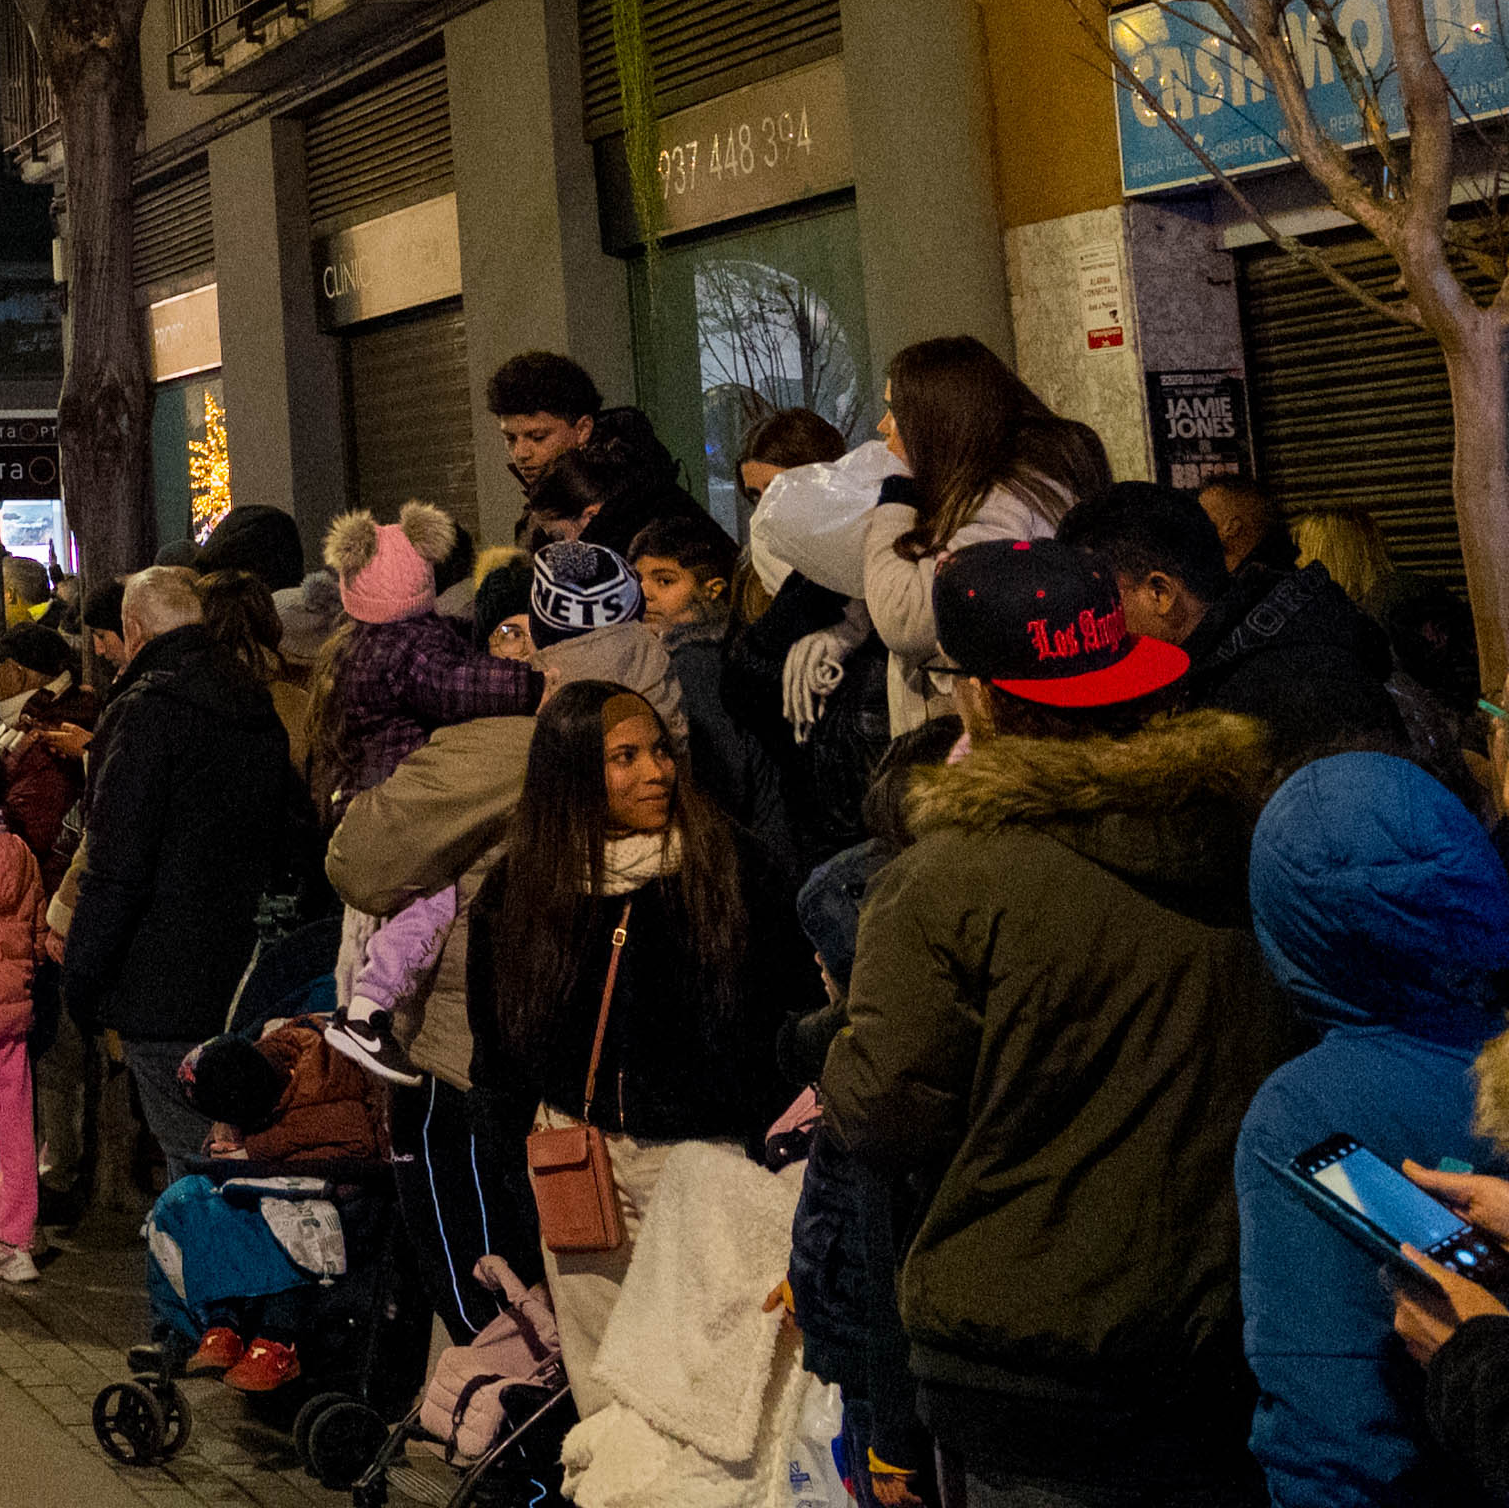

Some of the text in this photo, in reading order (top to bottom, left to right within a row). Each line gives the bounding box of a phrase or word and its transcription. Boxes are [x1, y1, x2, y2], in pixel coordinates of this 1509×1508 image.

[657, 105, 813, 201] 937 448 394
[1164, 396, 1234, 420] JAMIE
[1167, 417, 1237, 440] JONES
[535, 574, 624, 626] NETS
[1027, 618, 1080, 661] Los
